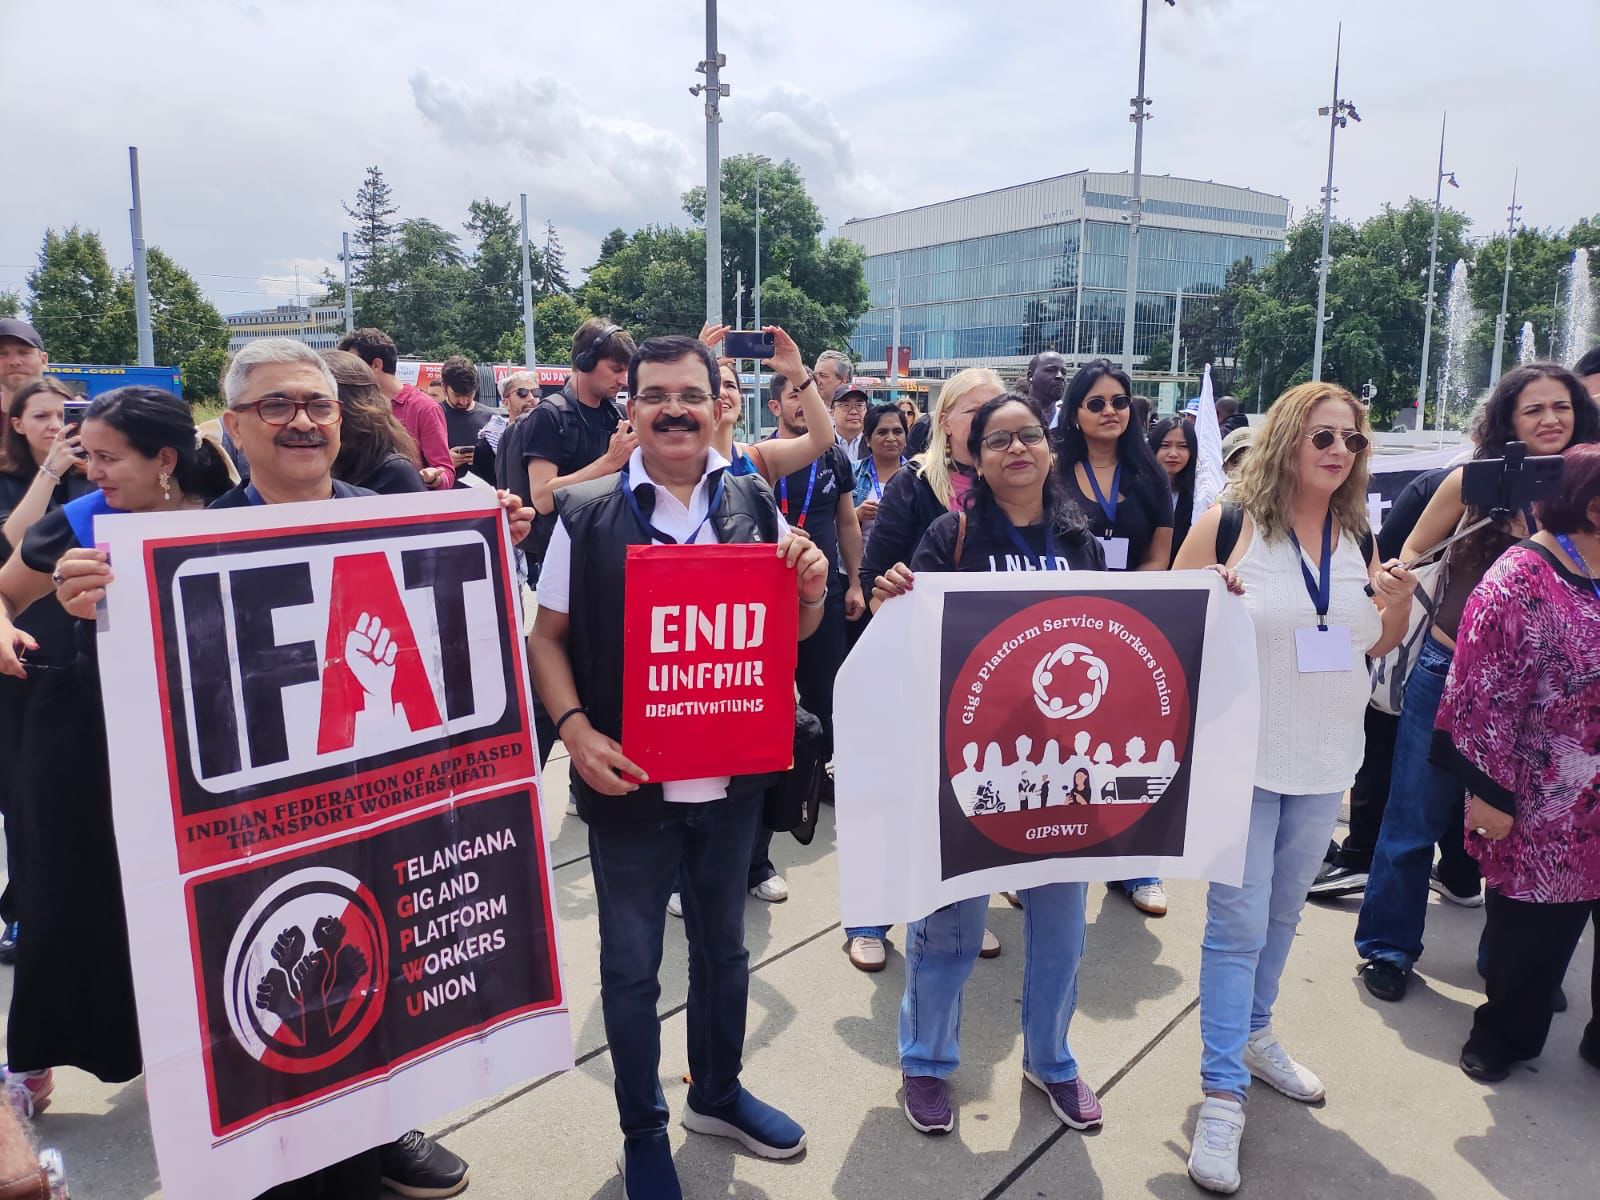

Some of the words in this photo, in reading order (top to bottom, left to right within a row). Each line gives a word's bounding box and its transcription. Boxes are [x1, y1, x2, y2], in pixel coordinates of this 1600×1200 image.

[651, 602, 767, 654] END
[178, 542, 487, 780] IFAT
[648, 660, 765, 692] UNFAIR
[961, 695, 980, 725] Gig
[971, 681, 984, 694] &
[978, 625, 1042, 681] Platform
[1043, 613, 1104, 632] Service
[1107, 619, 1157, 669] Workers
[1152, 666, 1172, 717] Union
[645, 698, 765, 718] DEACTIVATIONS
[187, 809, 268, 842] INDIAN
[274, 777, 398, 821] FEDERATION
[401, 768, 427, 788] OF
[429, 757, 464, 779] APP
[465, 742, 523, 768] BASED
[227, 803, 354, 849] TRANSPORT
[360, 778, 448, 816] WORKERS
[449, 761, 497, 790] (IFAT)
[393, 828, 517, 885] TELANGANA
[1025, 823, 1089, 840] GIPSWU
[397, 888, 435, 918] GIG
[438, 871, 480, 905] AND
[400, 894, 508, 952] PLATFORM
[402, 928, 506, 983] WORKERS
[406, 971, 477, 1016] UNION
